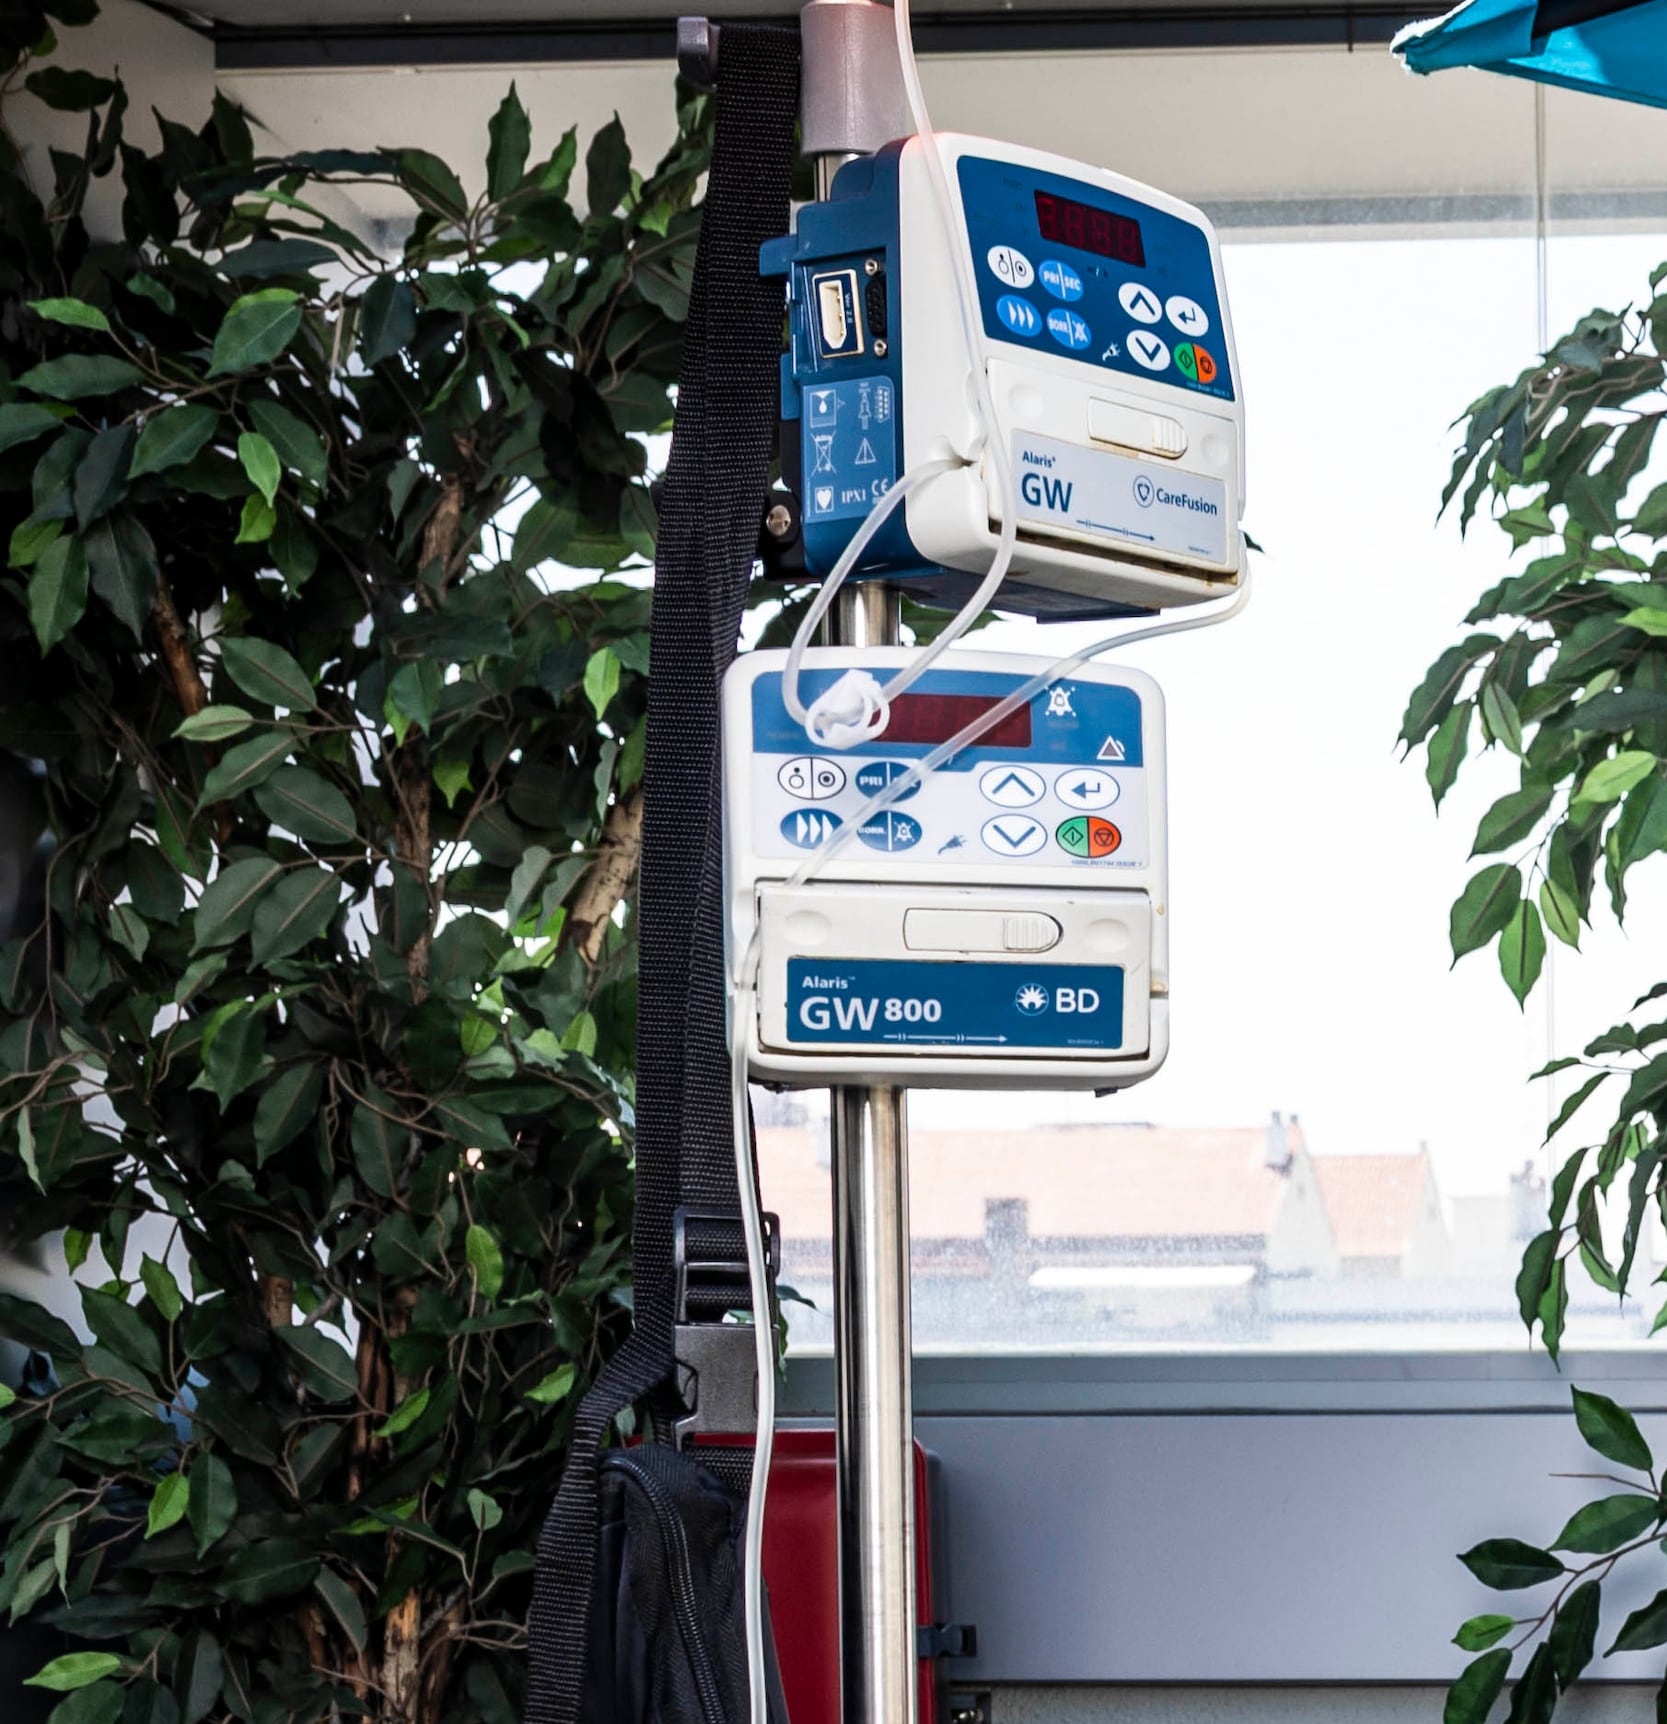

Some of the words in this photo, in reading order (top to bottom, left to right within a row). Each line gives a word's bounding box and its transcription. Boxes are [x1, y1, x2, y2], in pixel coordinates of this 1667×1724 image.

[1043, 270, 1060, 285] PRI
[1064, 275, 1081, 291] SEC
[1021, 472, 1073, 513] GW
[1156, 487, 1218, 516] CareFusion
[859, 776, 883, 787] PRI
[799, 995, 880, 1032] GW
[883, 997, 943, 1022] 800
[1055, 987, 1100, 1014] BD
